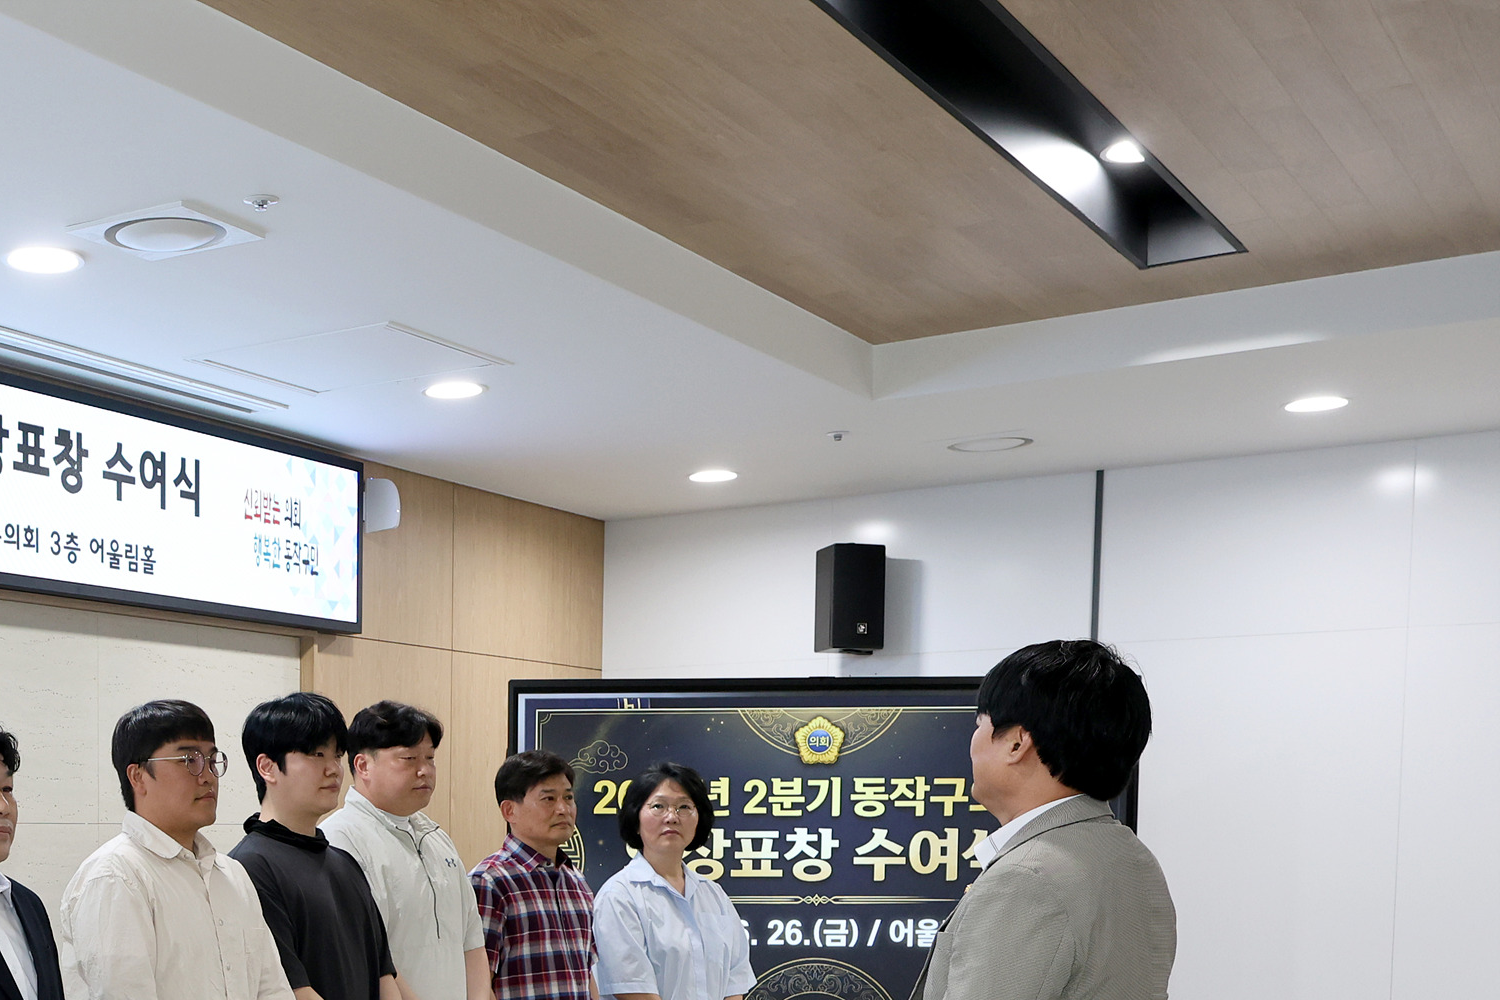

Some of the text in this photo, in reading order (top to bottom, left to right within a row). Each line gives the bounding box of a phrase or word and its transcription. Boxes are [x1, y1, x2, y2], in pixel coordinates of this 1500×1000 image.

[102, 442, 200, 518] 수여식
[244, 488, 301, 530] 신뢰받는 의회
[50, 530, 81, 564] 3층
[89, 538, 157, 576] 어울림홀
[253, 532, 319, 576] 행복한 동작구민
[809, 735, 829, 748] 의회
[743, 776, 842, 817] 2분기
[850, 776, 988, 818] 동작구
[626, 826, 840, 883] 장표창
[766, 918, 859, 948] 26.(금)
